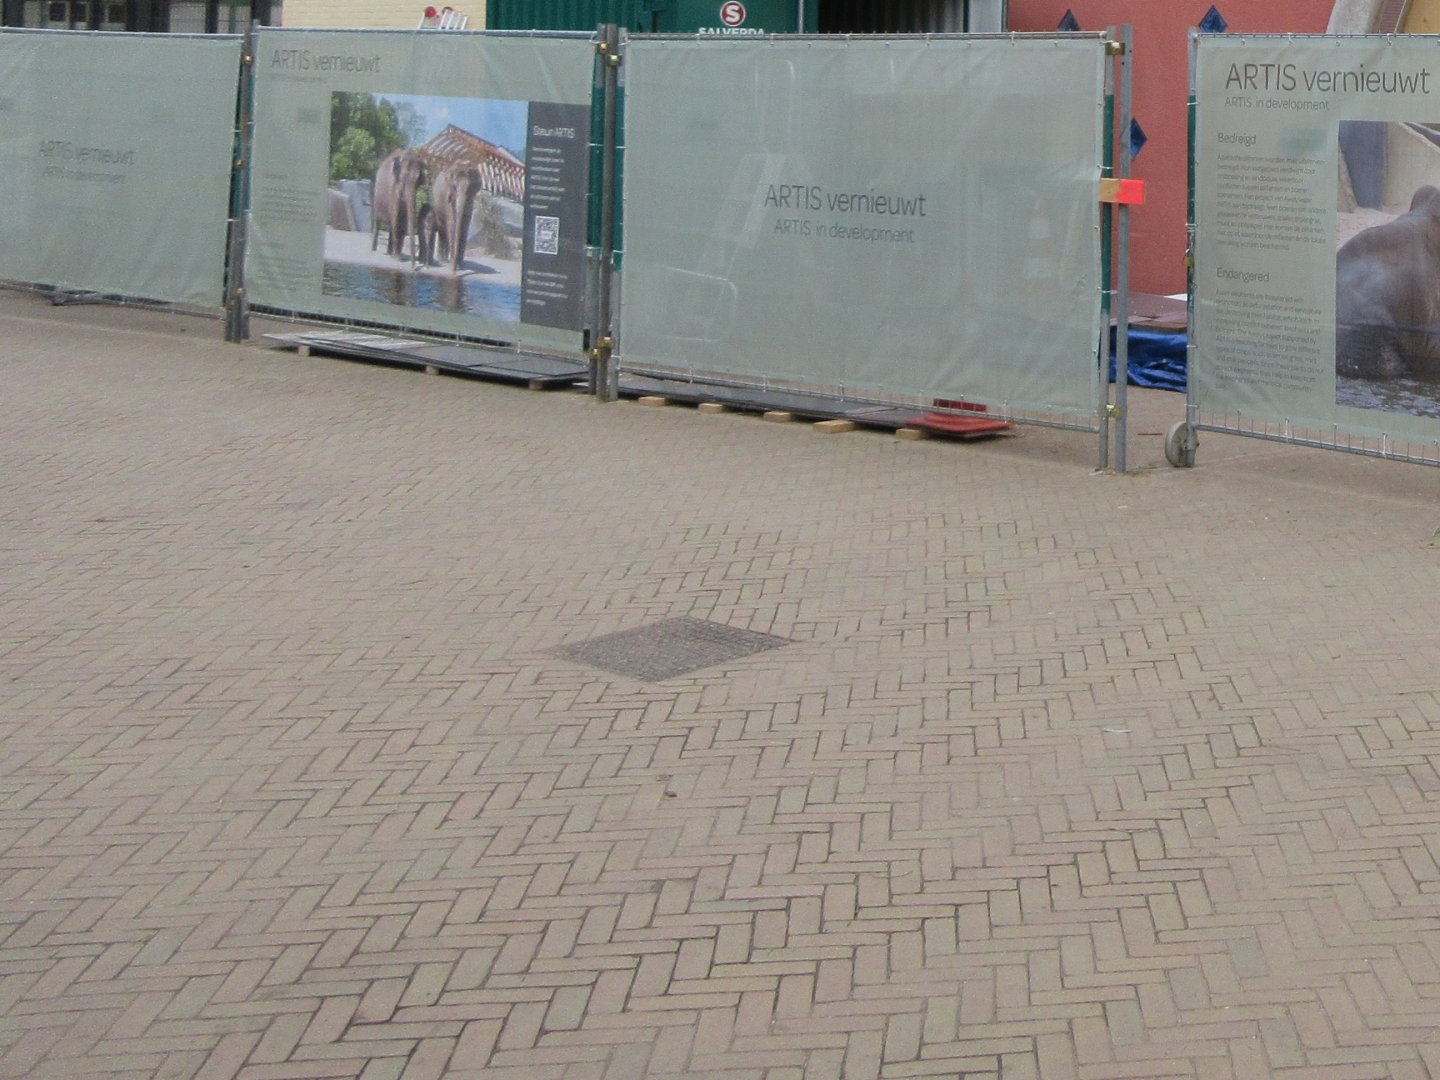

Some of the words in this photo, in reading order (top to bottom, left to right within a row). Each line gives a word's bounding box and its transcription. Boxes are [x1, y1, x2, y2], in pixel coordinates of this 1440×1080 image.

[271, 50, 310, 70] ARTIS
[314, 55, 382, 73] vernieuwt
[1226, 63, 1297, 92] ARTIS
[1303, 64, 1430, 94] vernieuwt
[1224, 96, 1252, 108] ARTIS
[1255, 98, 1264, 108] in
[1265, 97, 1330, 111] development
[1217, 132, 1257, 147] Bedreigd
[764, 184, 822, 210] ARTIS
[827, 188, 926, 216] vernieuwt
[774, 218, 812, 236] ARTIS
[816, 222, 826, 237] in
[829, 222, 916, 244] development
[1216, 267, 1270, 283] Endangered
